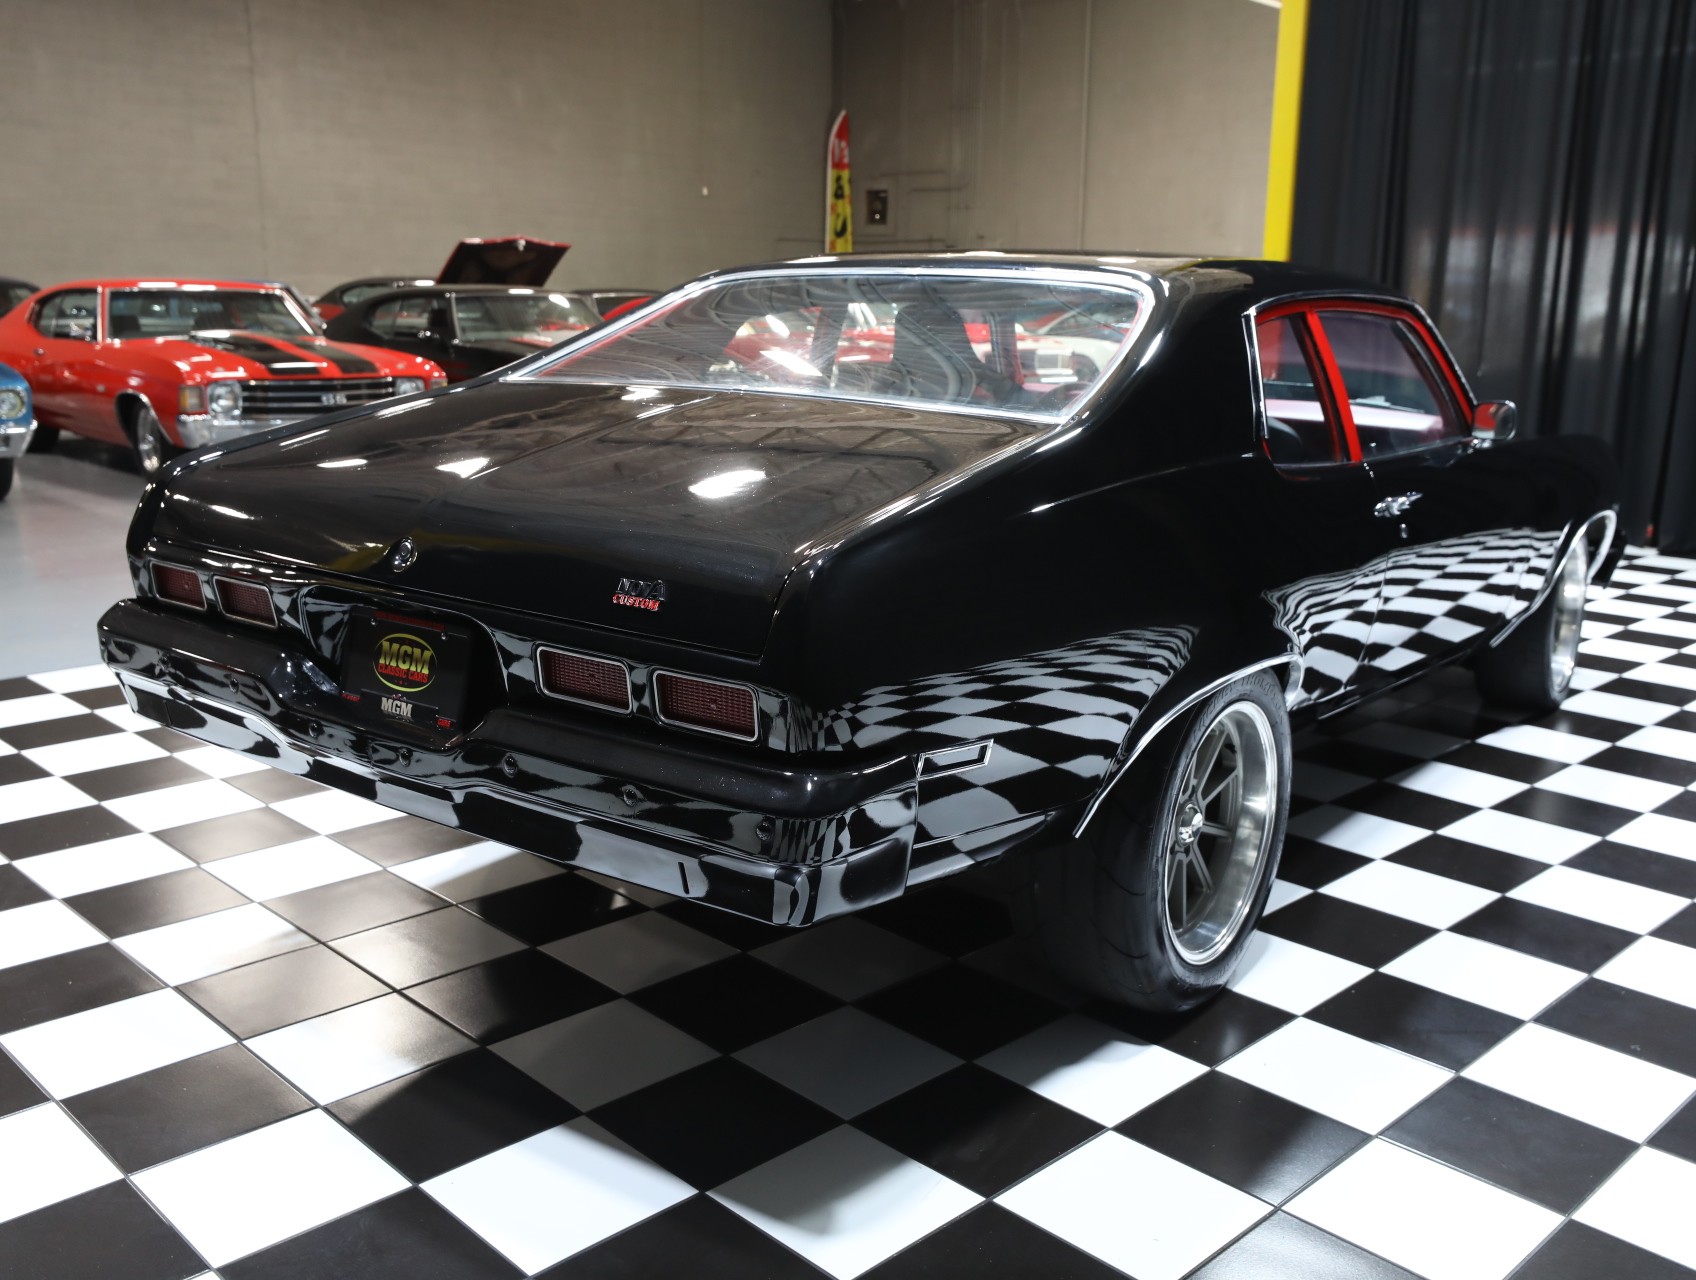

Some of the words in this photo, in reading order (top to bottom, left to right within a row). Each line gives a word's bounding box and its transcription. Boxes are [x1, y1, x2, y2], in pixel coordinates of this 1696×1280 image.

[612, 594, 660, 611] CUSTOM
[379, 640, 432, 675] MGM
[378, 662, 407, 679] CLASSIC
[408, 670, 429, 684] CARS
[381, 697, 413, 718] MGM
